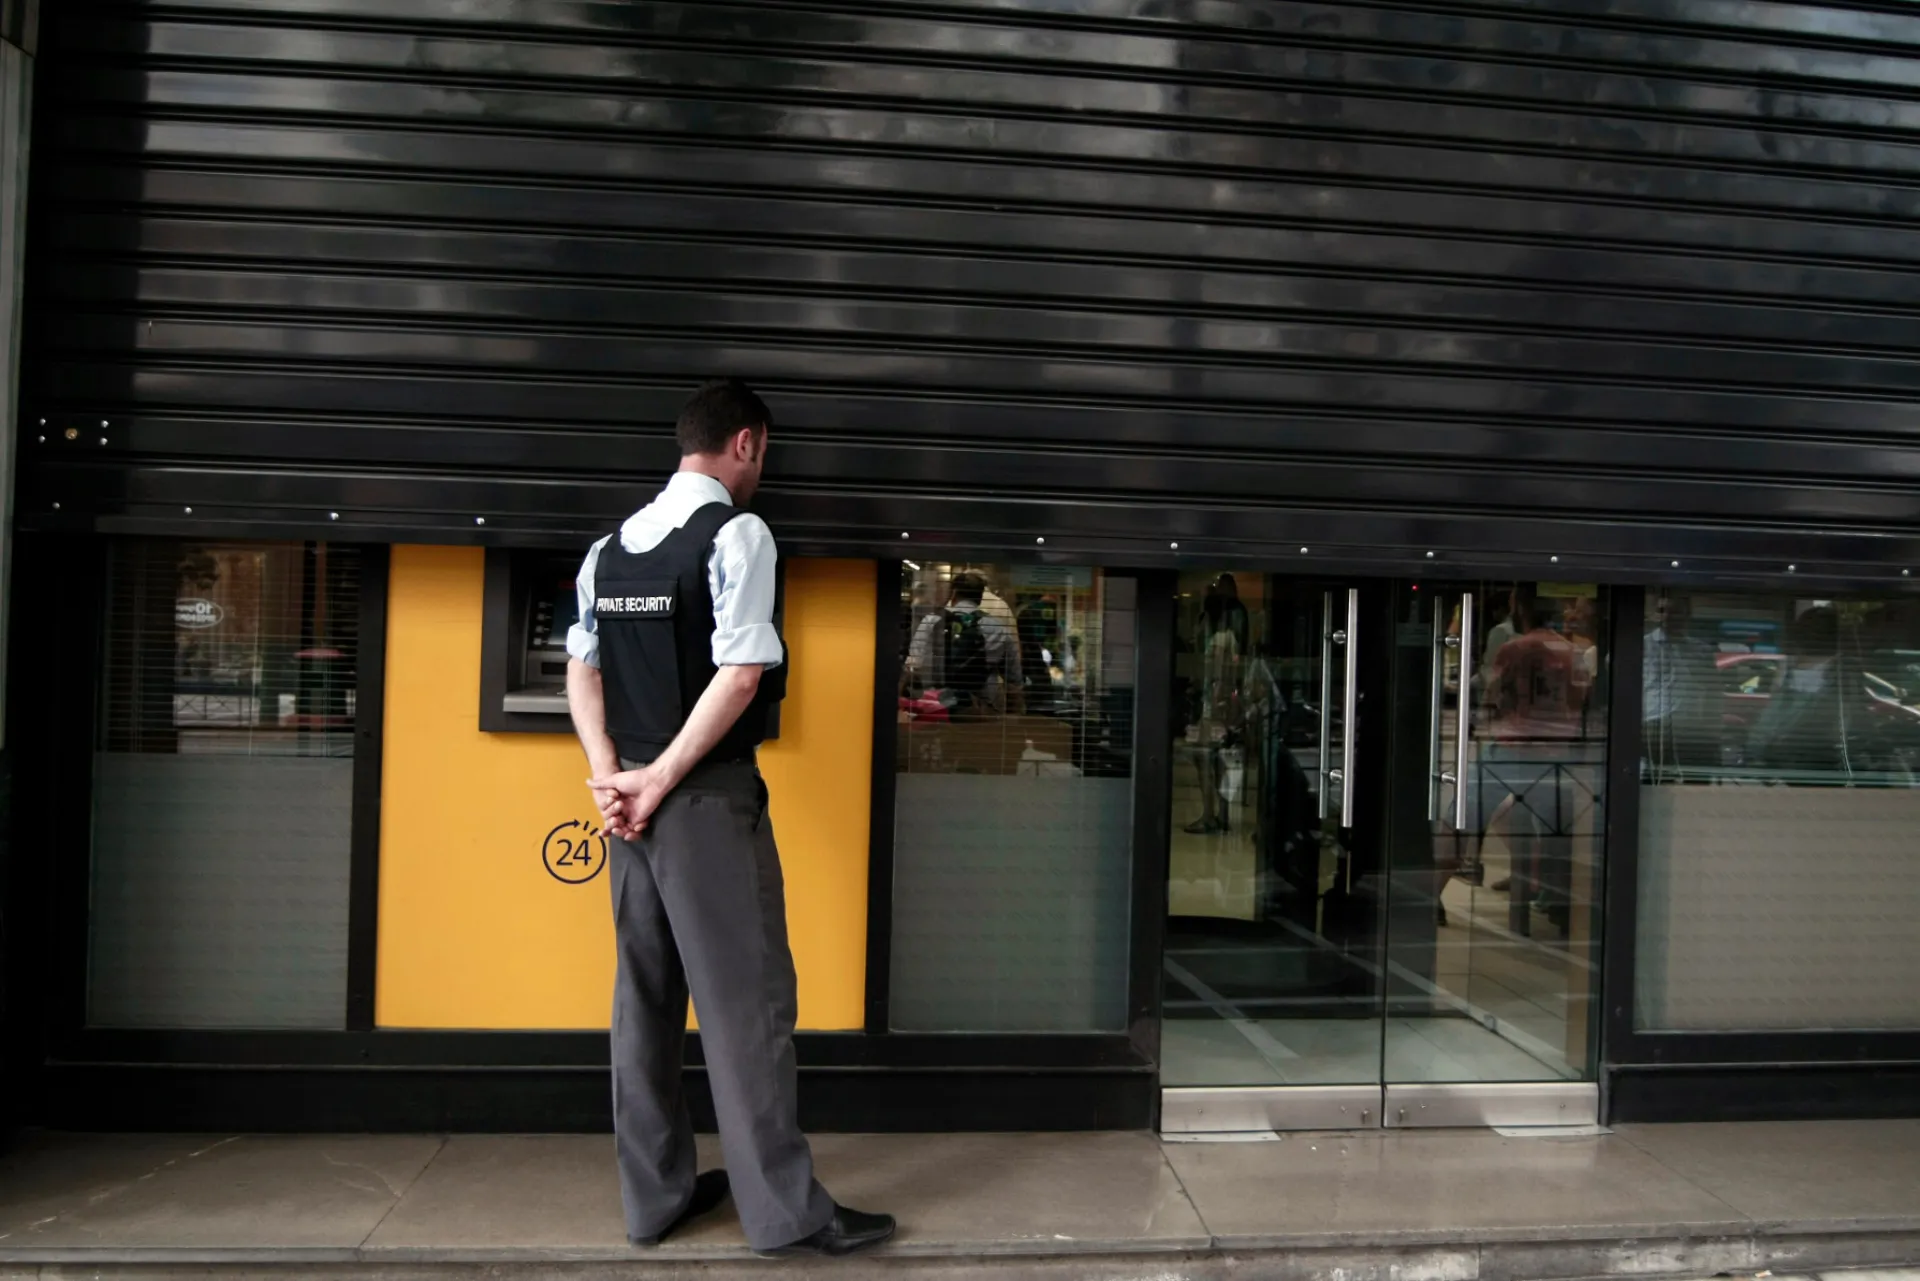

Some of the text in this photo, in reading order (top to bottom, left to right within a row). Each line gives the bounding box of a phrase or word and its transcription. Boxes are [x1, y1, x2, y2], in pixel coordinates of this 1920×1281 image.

[596, 596, 672, 612] PRIVATE SECURITY
[556, 838, 592, 866] 24
